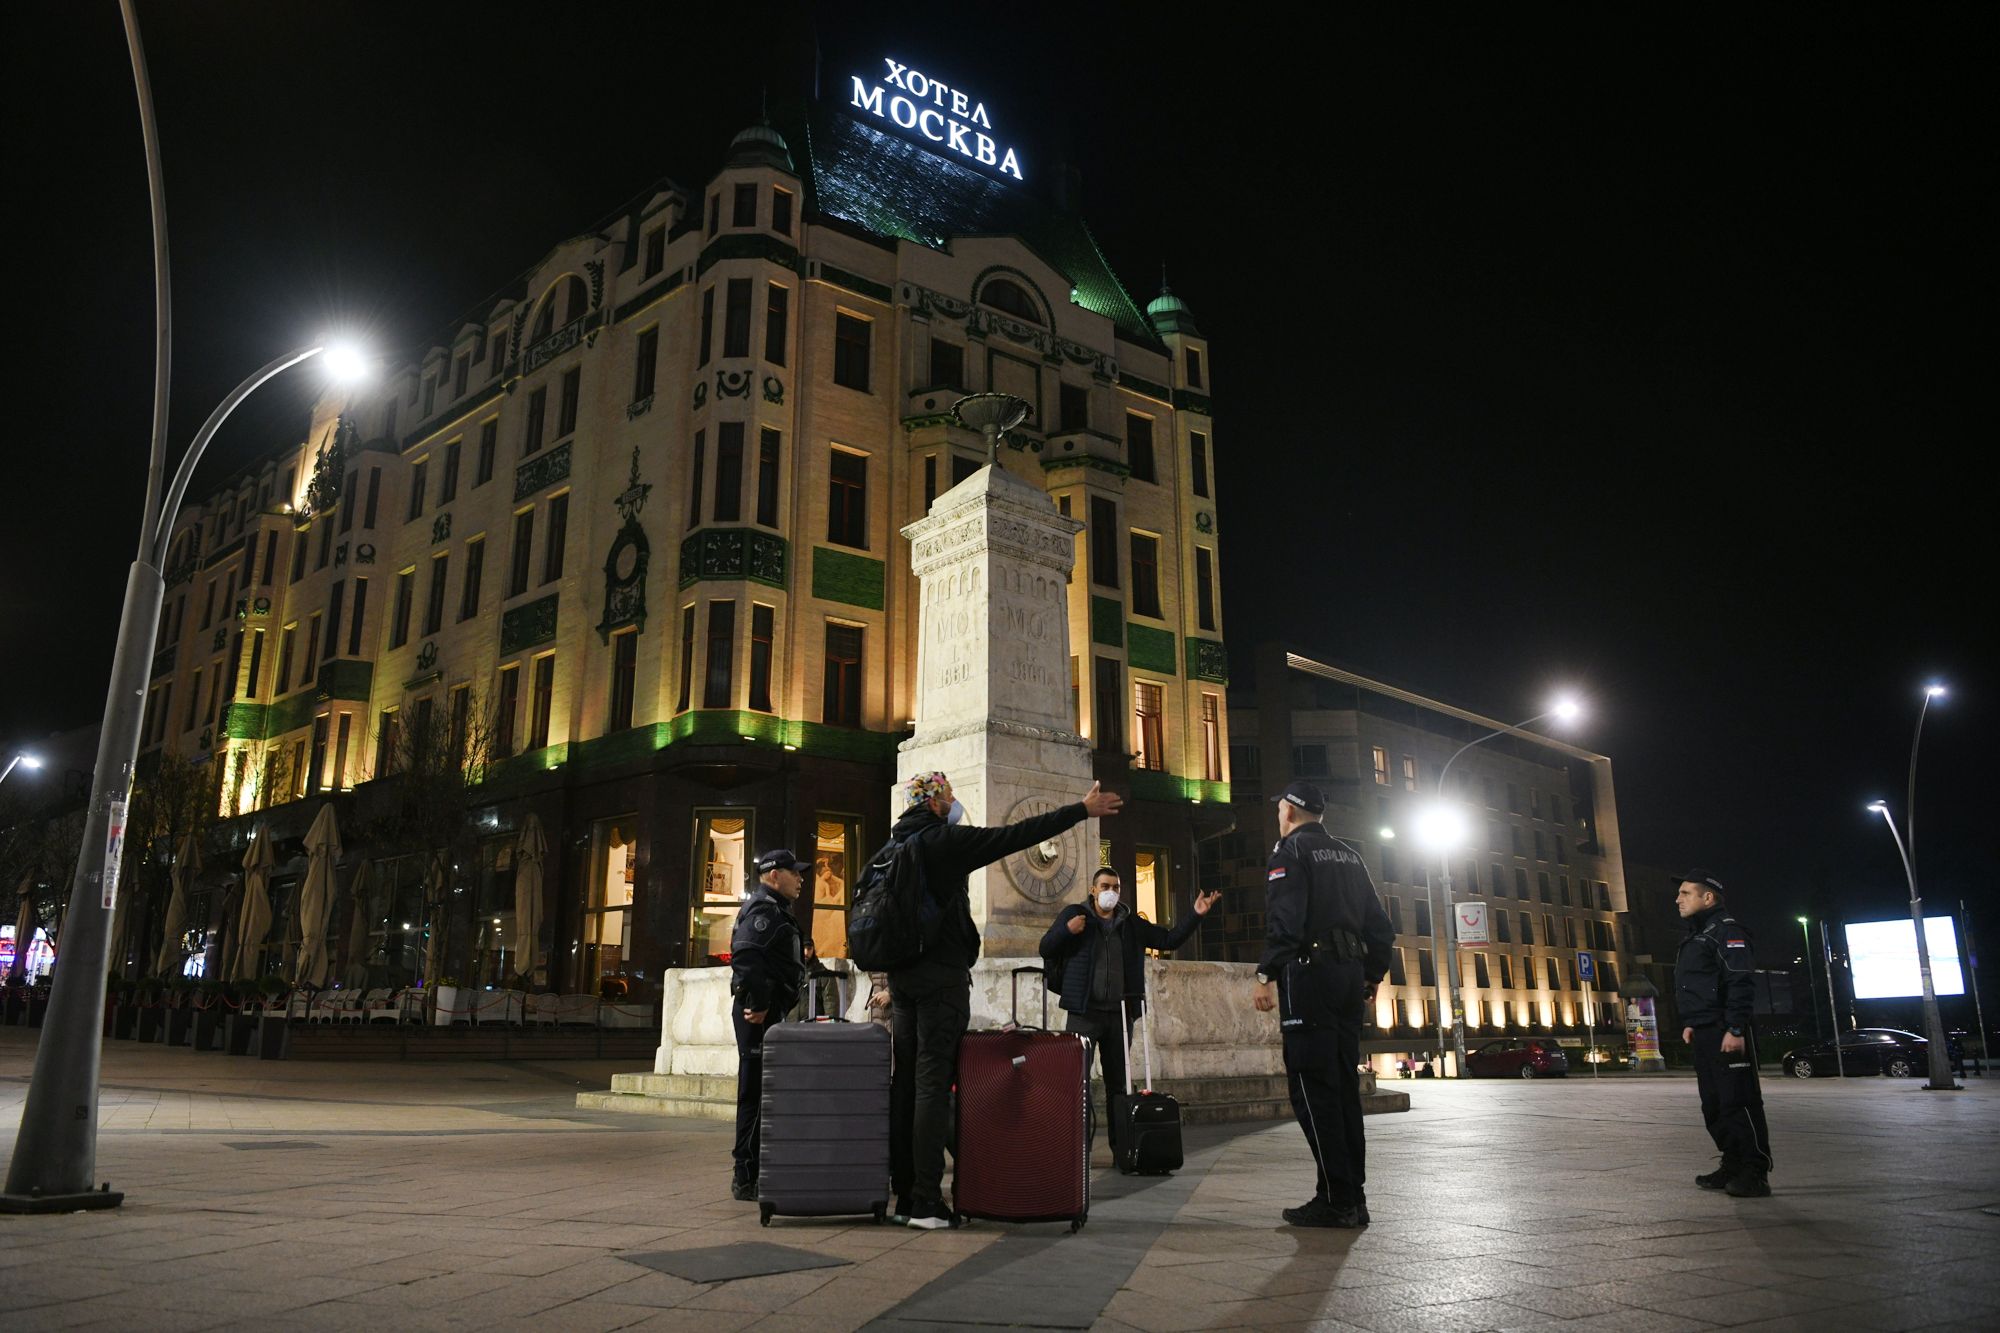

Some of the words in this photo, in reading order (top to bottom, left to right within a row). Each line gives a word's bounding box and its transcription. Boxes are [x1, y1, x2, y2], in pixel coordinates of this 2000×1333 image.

[850, 75, 1024, 181] МОСКВА
[884, 57, 992, 130] ХОТЕЛ
[1580, 954, 1590, 973] P
